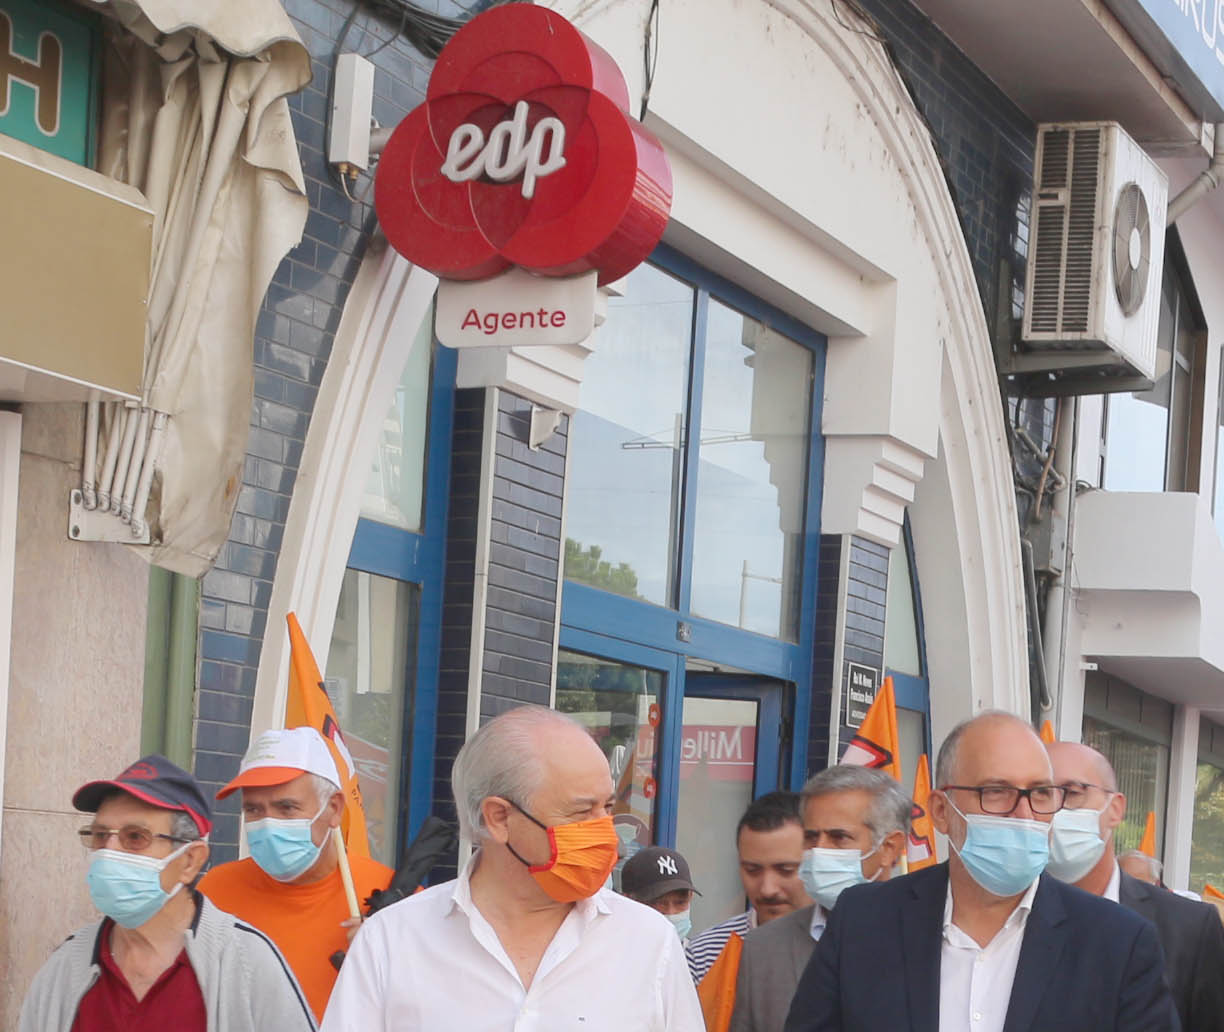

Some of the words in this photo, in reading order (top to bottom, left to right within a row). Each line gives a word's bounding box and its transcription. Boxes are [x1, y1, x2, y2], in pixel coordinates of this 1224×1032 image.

[440, 100, 567, 199] edp
[461, 307, 566, 335] Agente
[657, 855, 678, 875] NY
